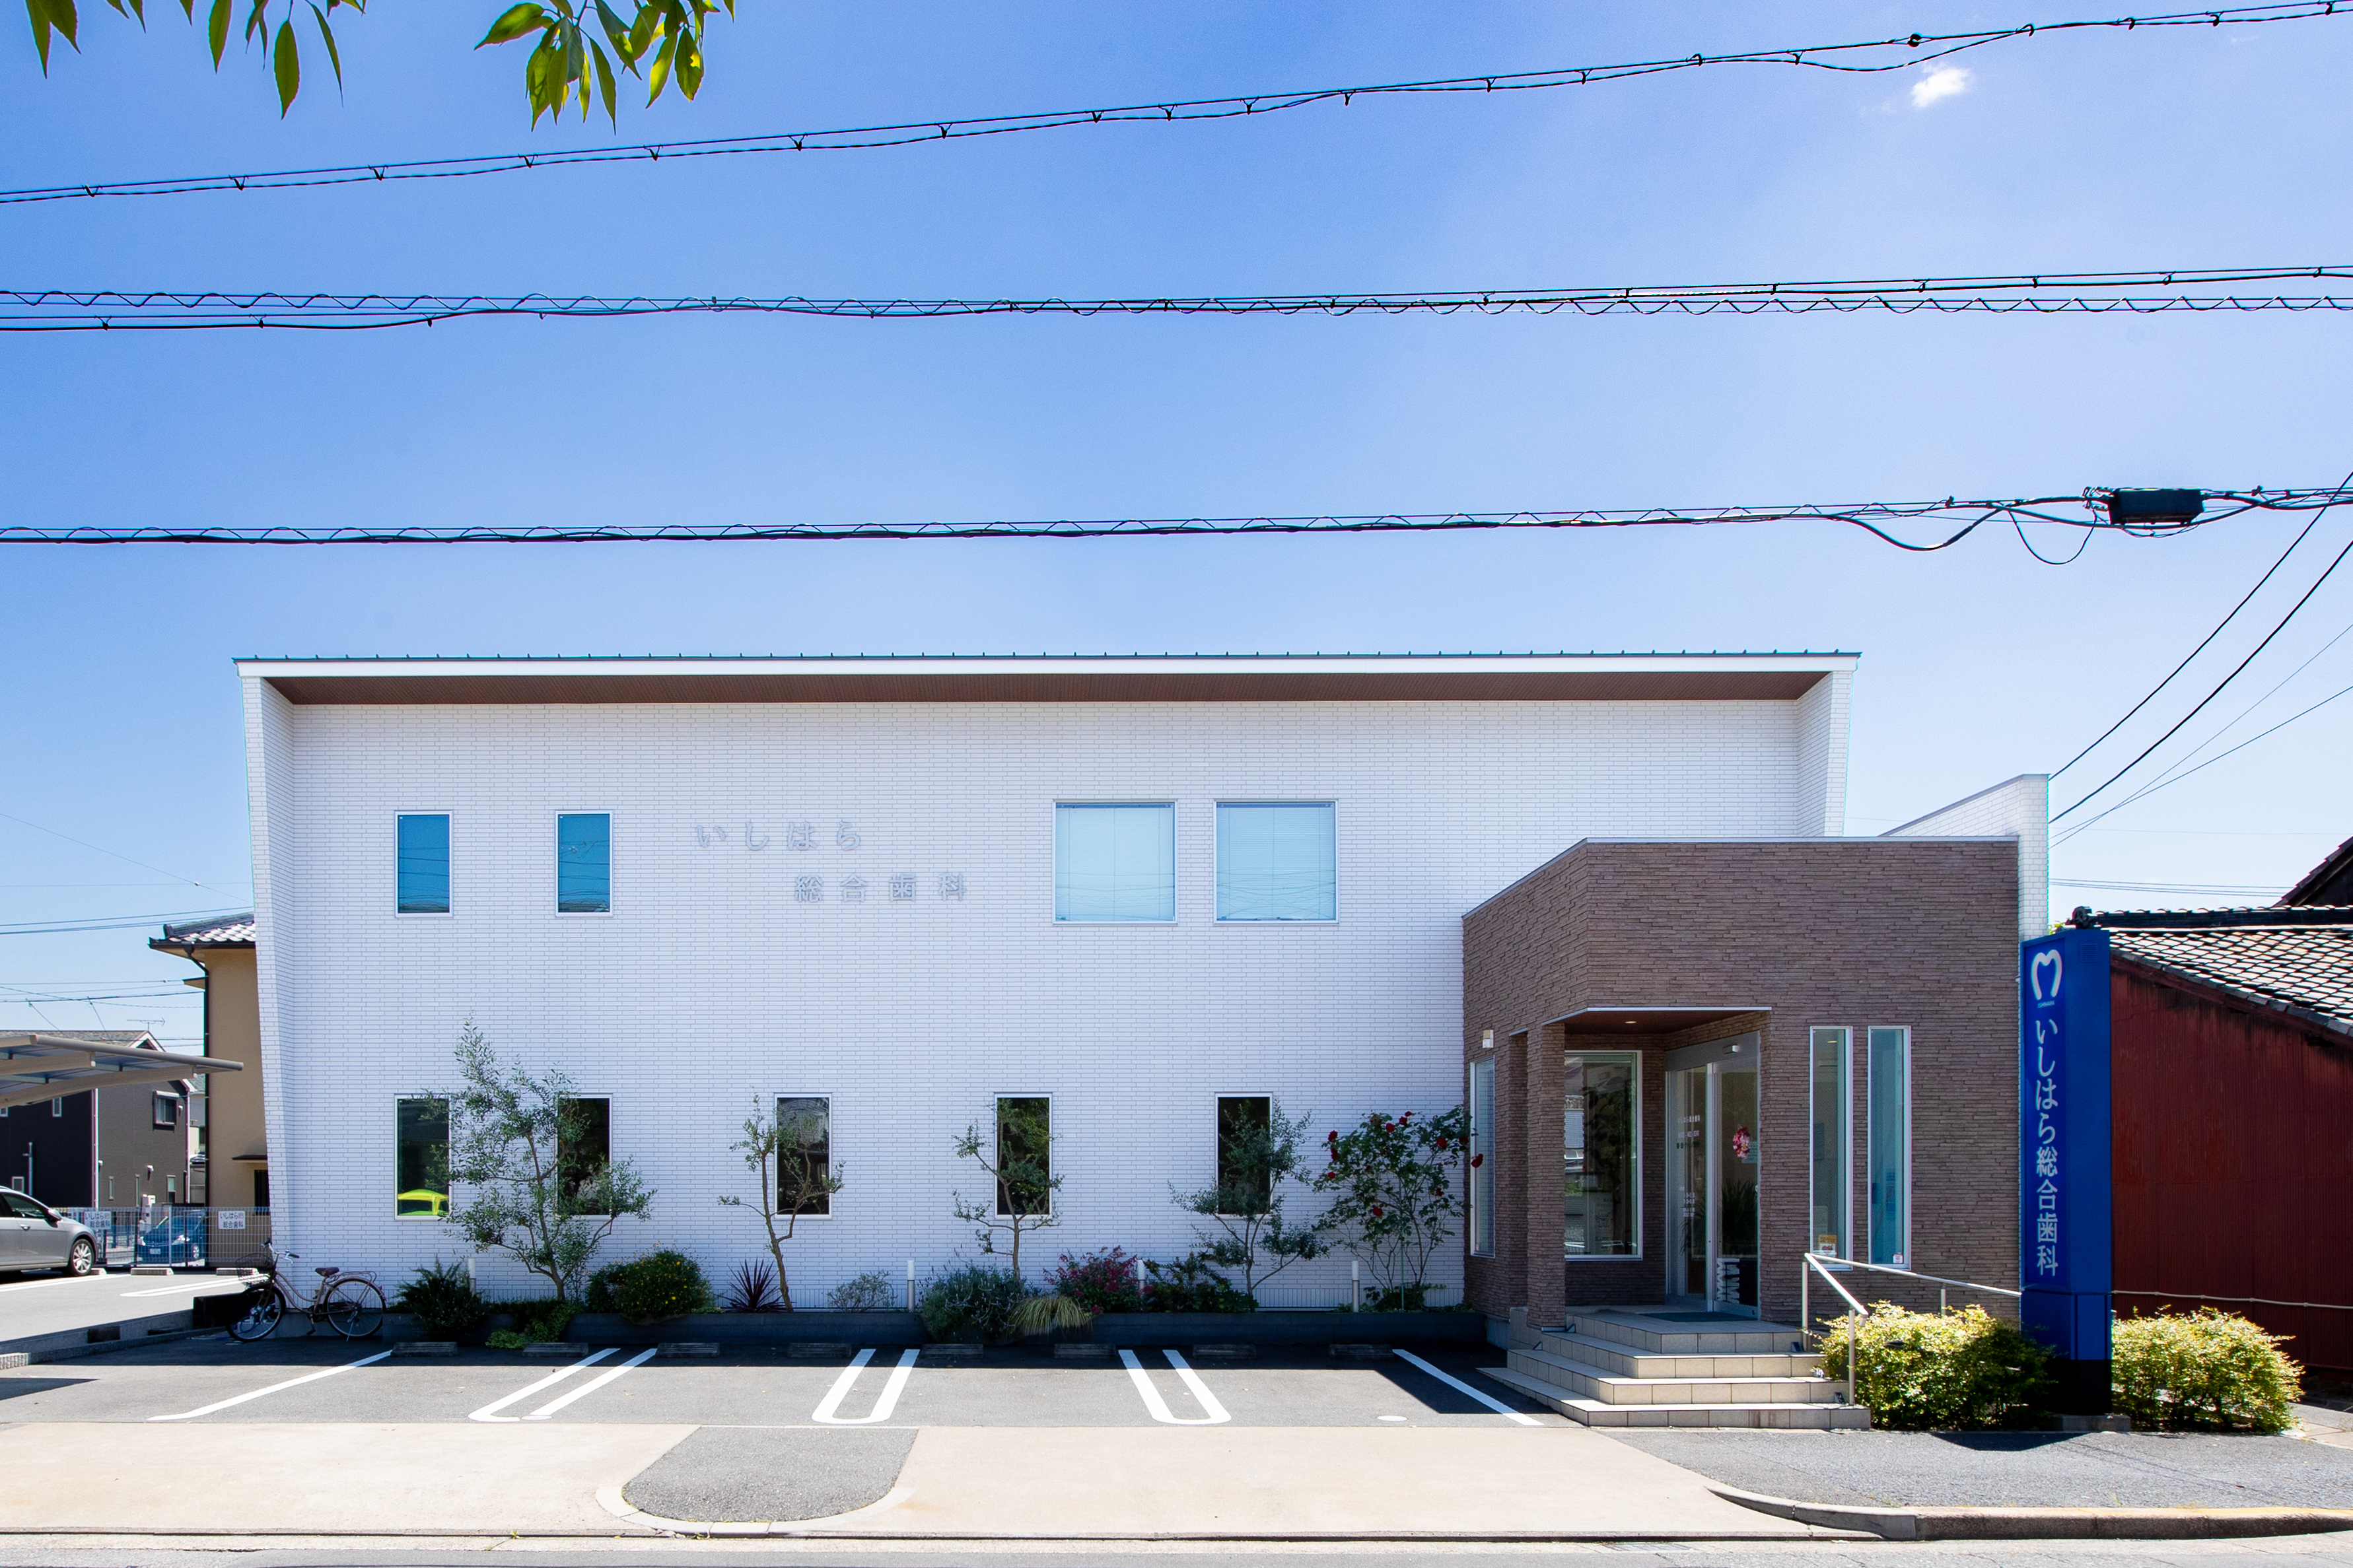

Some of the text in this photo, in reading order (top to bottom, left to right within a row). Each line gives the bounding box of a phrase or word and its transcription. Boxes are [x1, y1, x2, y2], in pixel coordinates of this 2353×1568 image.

[695, 821, 860, 852] いしはら
[794, 872, 967, 903] 総合歯科
[2035, 1019, 2058, 1276] いしはら総合歯科
